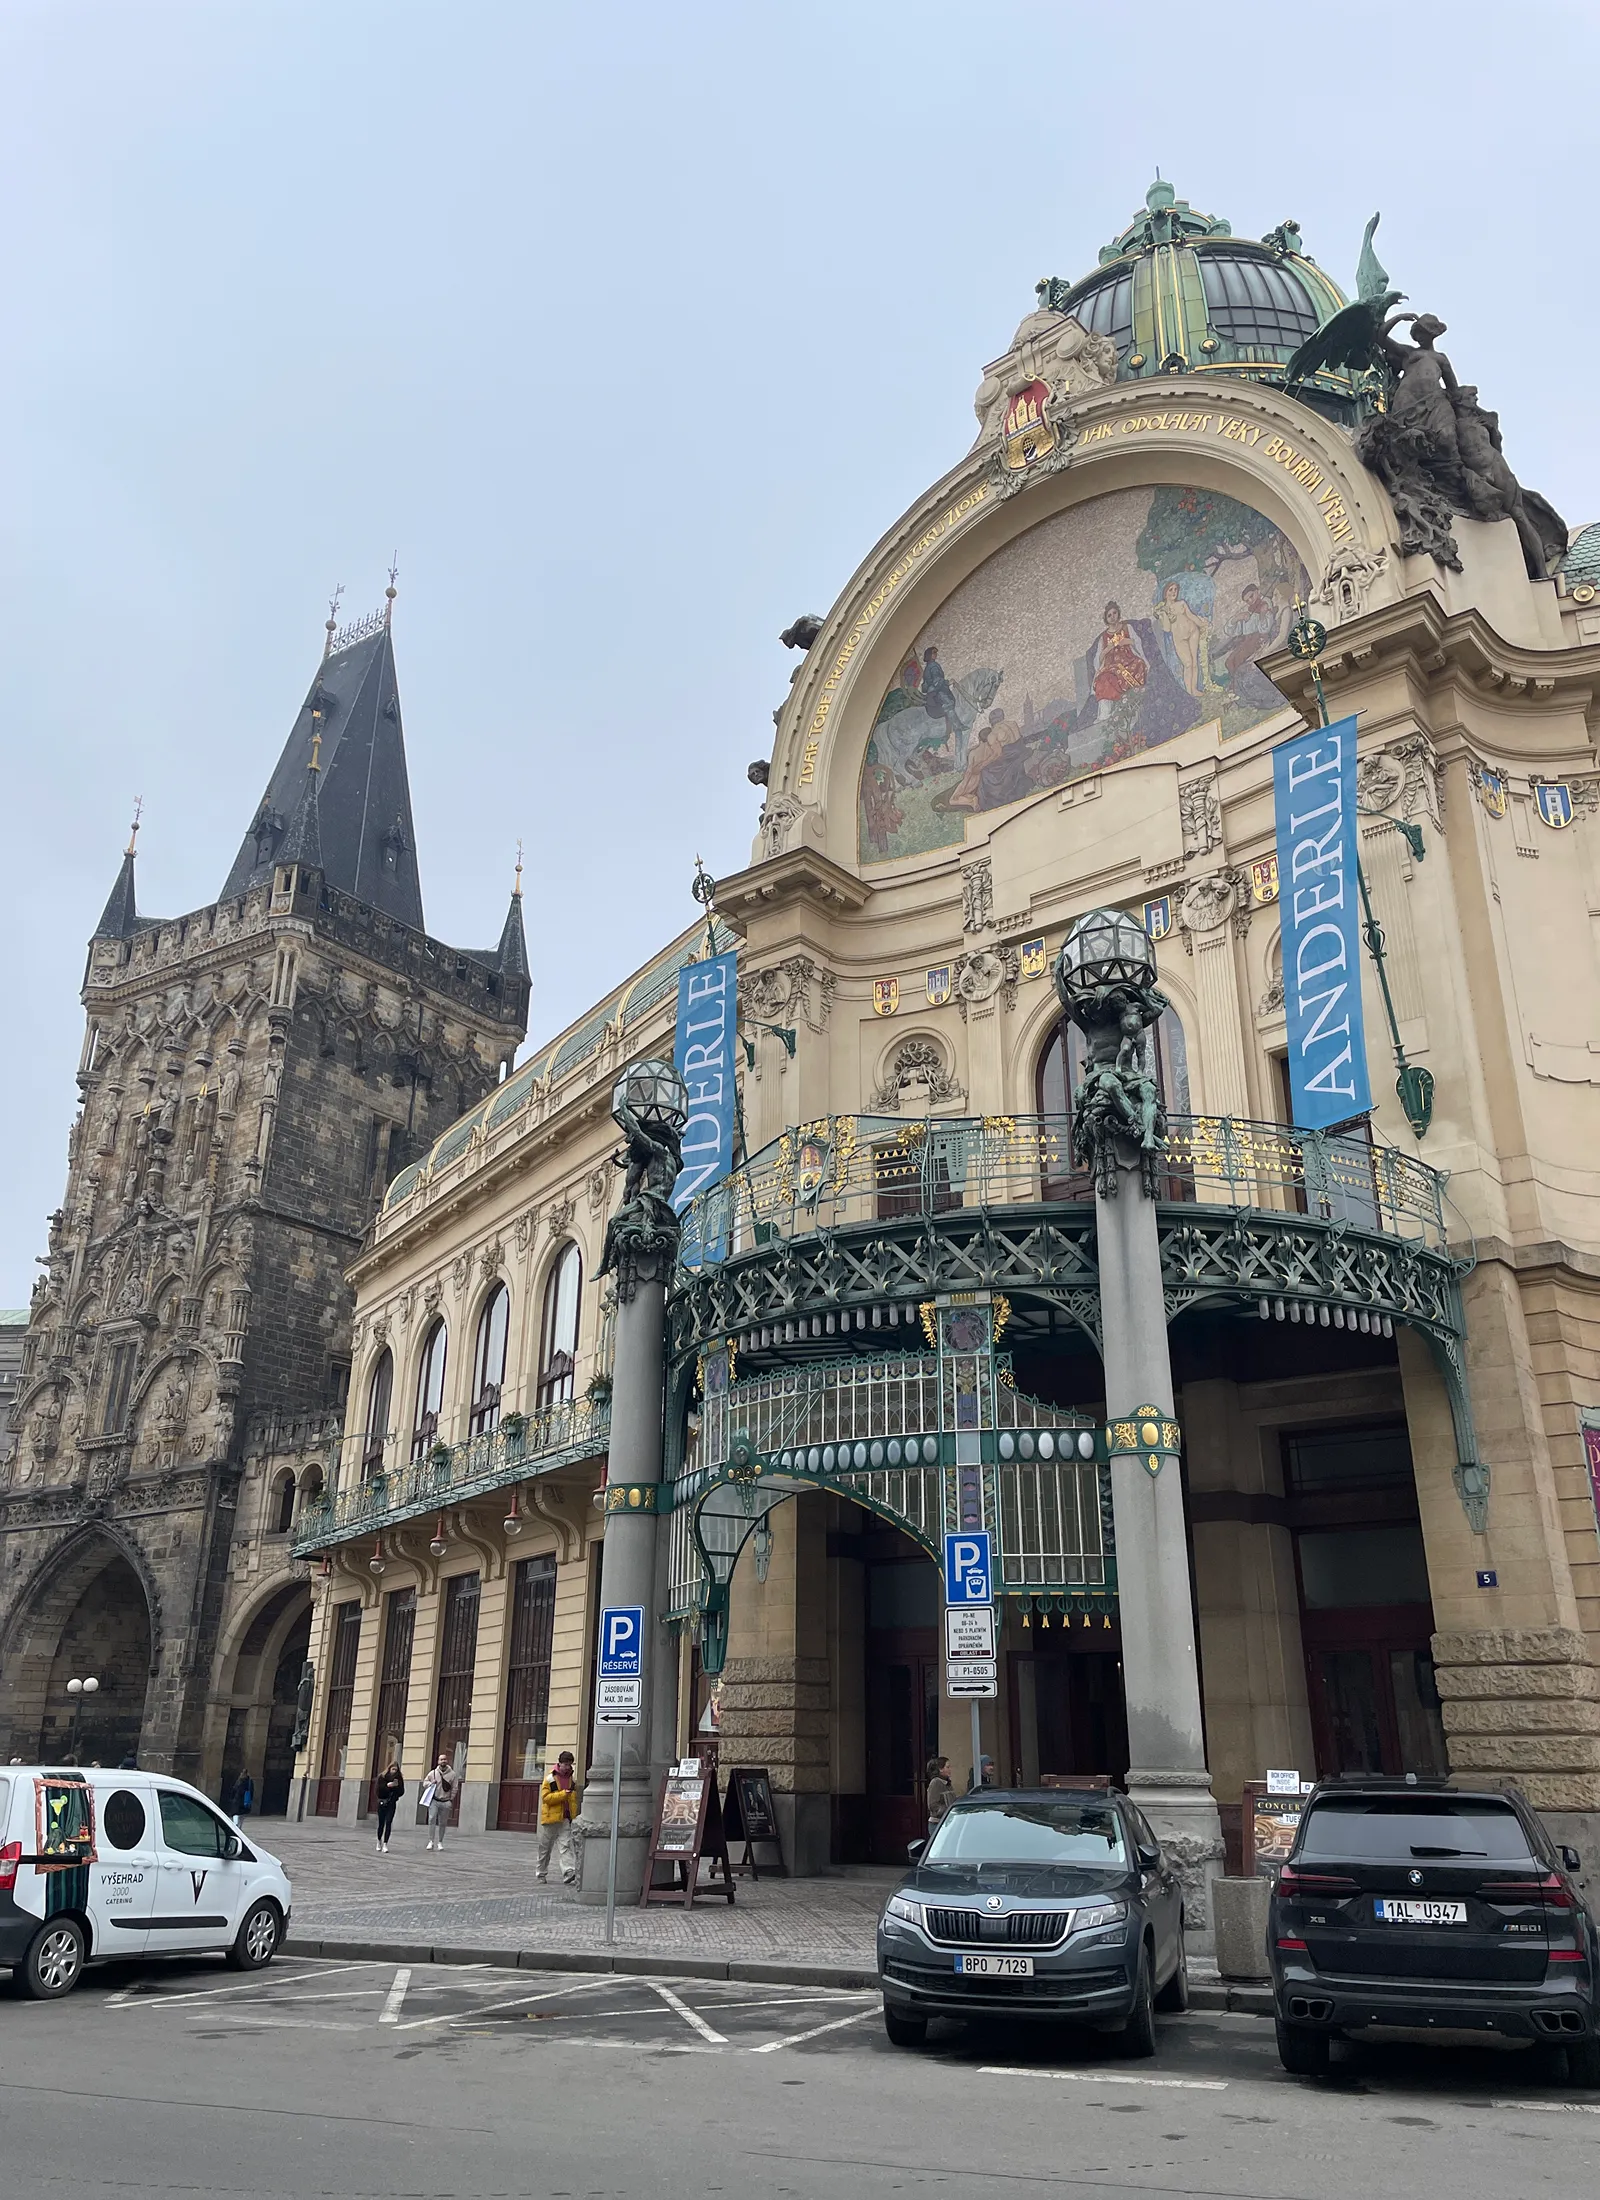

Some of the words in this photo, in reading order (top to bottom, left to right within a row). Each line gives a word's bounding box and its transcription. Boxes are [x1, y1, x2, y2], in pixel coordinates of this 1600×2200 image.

[1079, 420, 1119, 446] JAK
[1121, 413, 1213, 434] ODOLALAS
[798, 741, 820, 788] ZDAR
[856, 554, 914, 626] VZDORUJ
[1288, 735, 1356, 1101] ANDERLE
[954, 1541, 980, 1582] P
[1483, 1574, 1490, 1584] 5
[609, 1616, 634, 1655] P
[602, 1660, 638, 1670] RÉSERVÉ
[963, 1667, 988, 1675] P1-0505
[604, 1684, 634, 1694] ZÁSOBOVÁNÍ
[1257, 1801, 1304, 1811] CONCER
[101, 1872, 144, 1885] VYŠEHRAD
[112, 1887, 130, 1897] 2000
[105, 1897, 133, 1905] CATERING
[1387, 1902, 1413, 1917] 1AL
[1423, 1903, 1459, 1920] U347
[996, 1958, 1027, 1974] 7129
